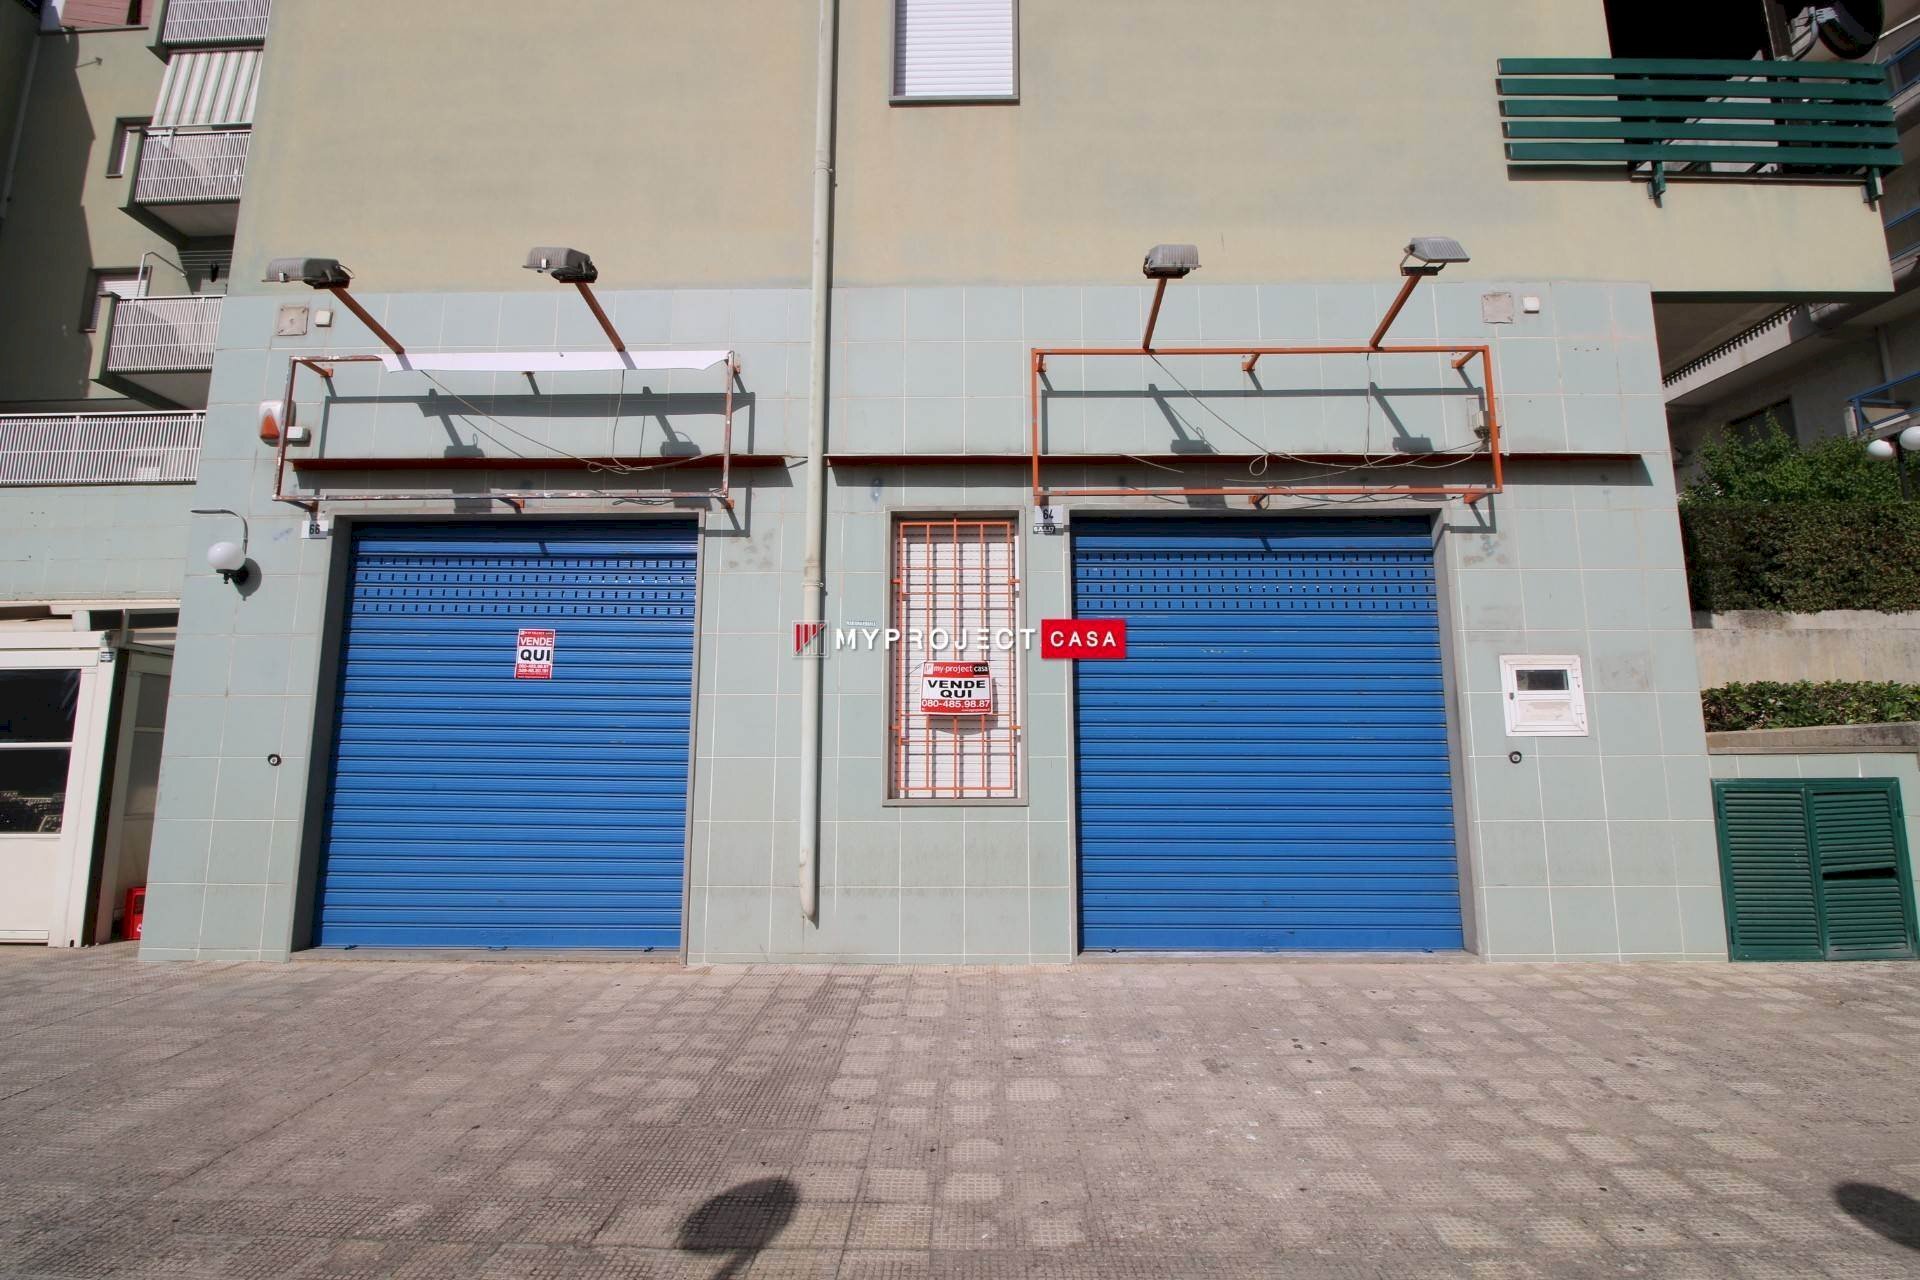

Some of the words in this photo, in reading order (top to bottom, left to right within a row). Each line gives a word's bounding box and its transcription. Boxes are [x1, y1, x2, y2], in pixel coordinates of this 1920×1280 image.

[1042, 509, 1054, 520] 64
[309, 524, 320, 535] 66
[519, 636, 553, 646] VENDE
[520, 648, 551, 662] QUI
[945, 664, 973, 674] project
[973, 665, 989, 673] casa
[927, 680, 986, 689] VENDE
[940, 689, 972, 699] QUI
[921, 699, 990, 708] 080-485.98.87
